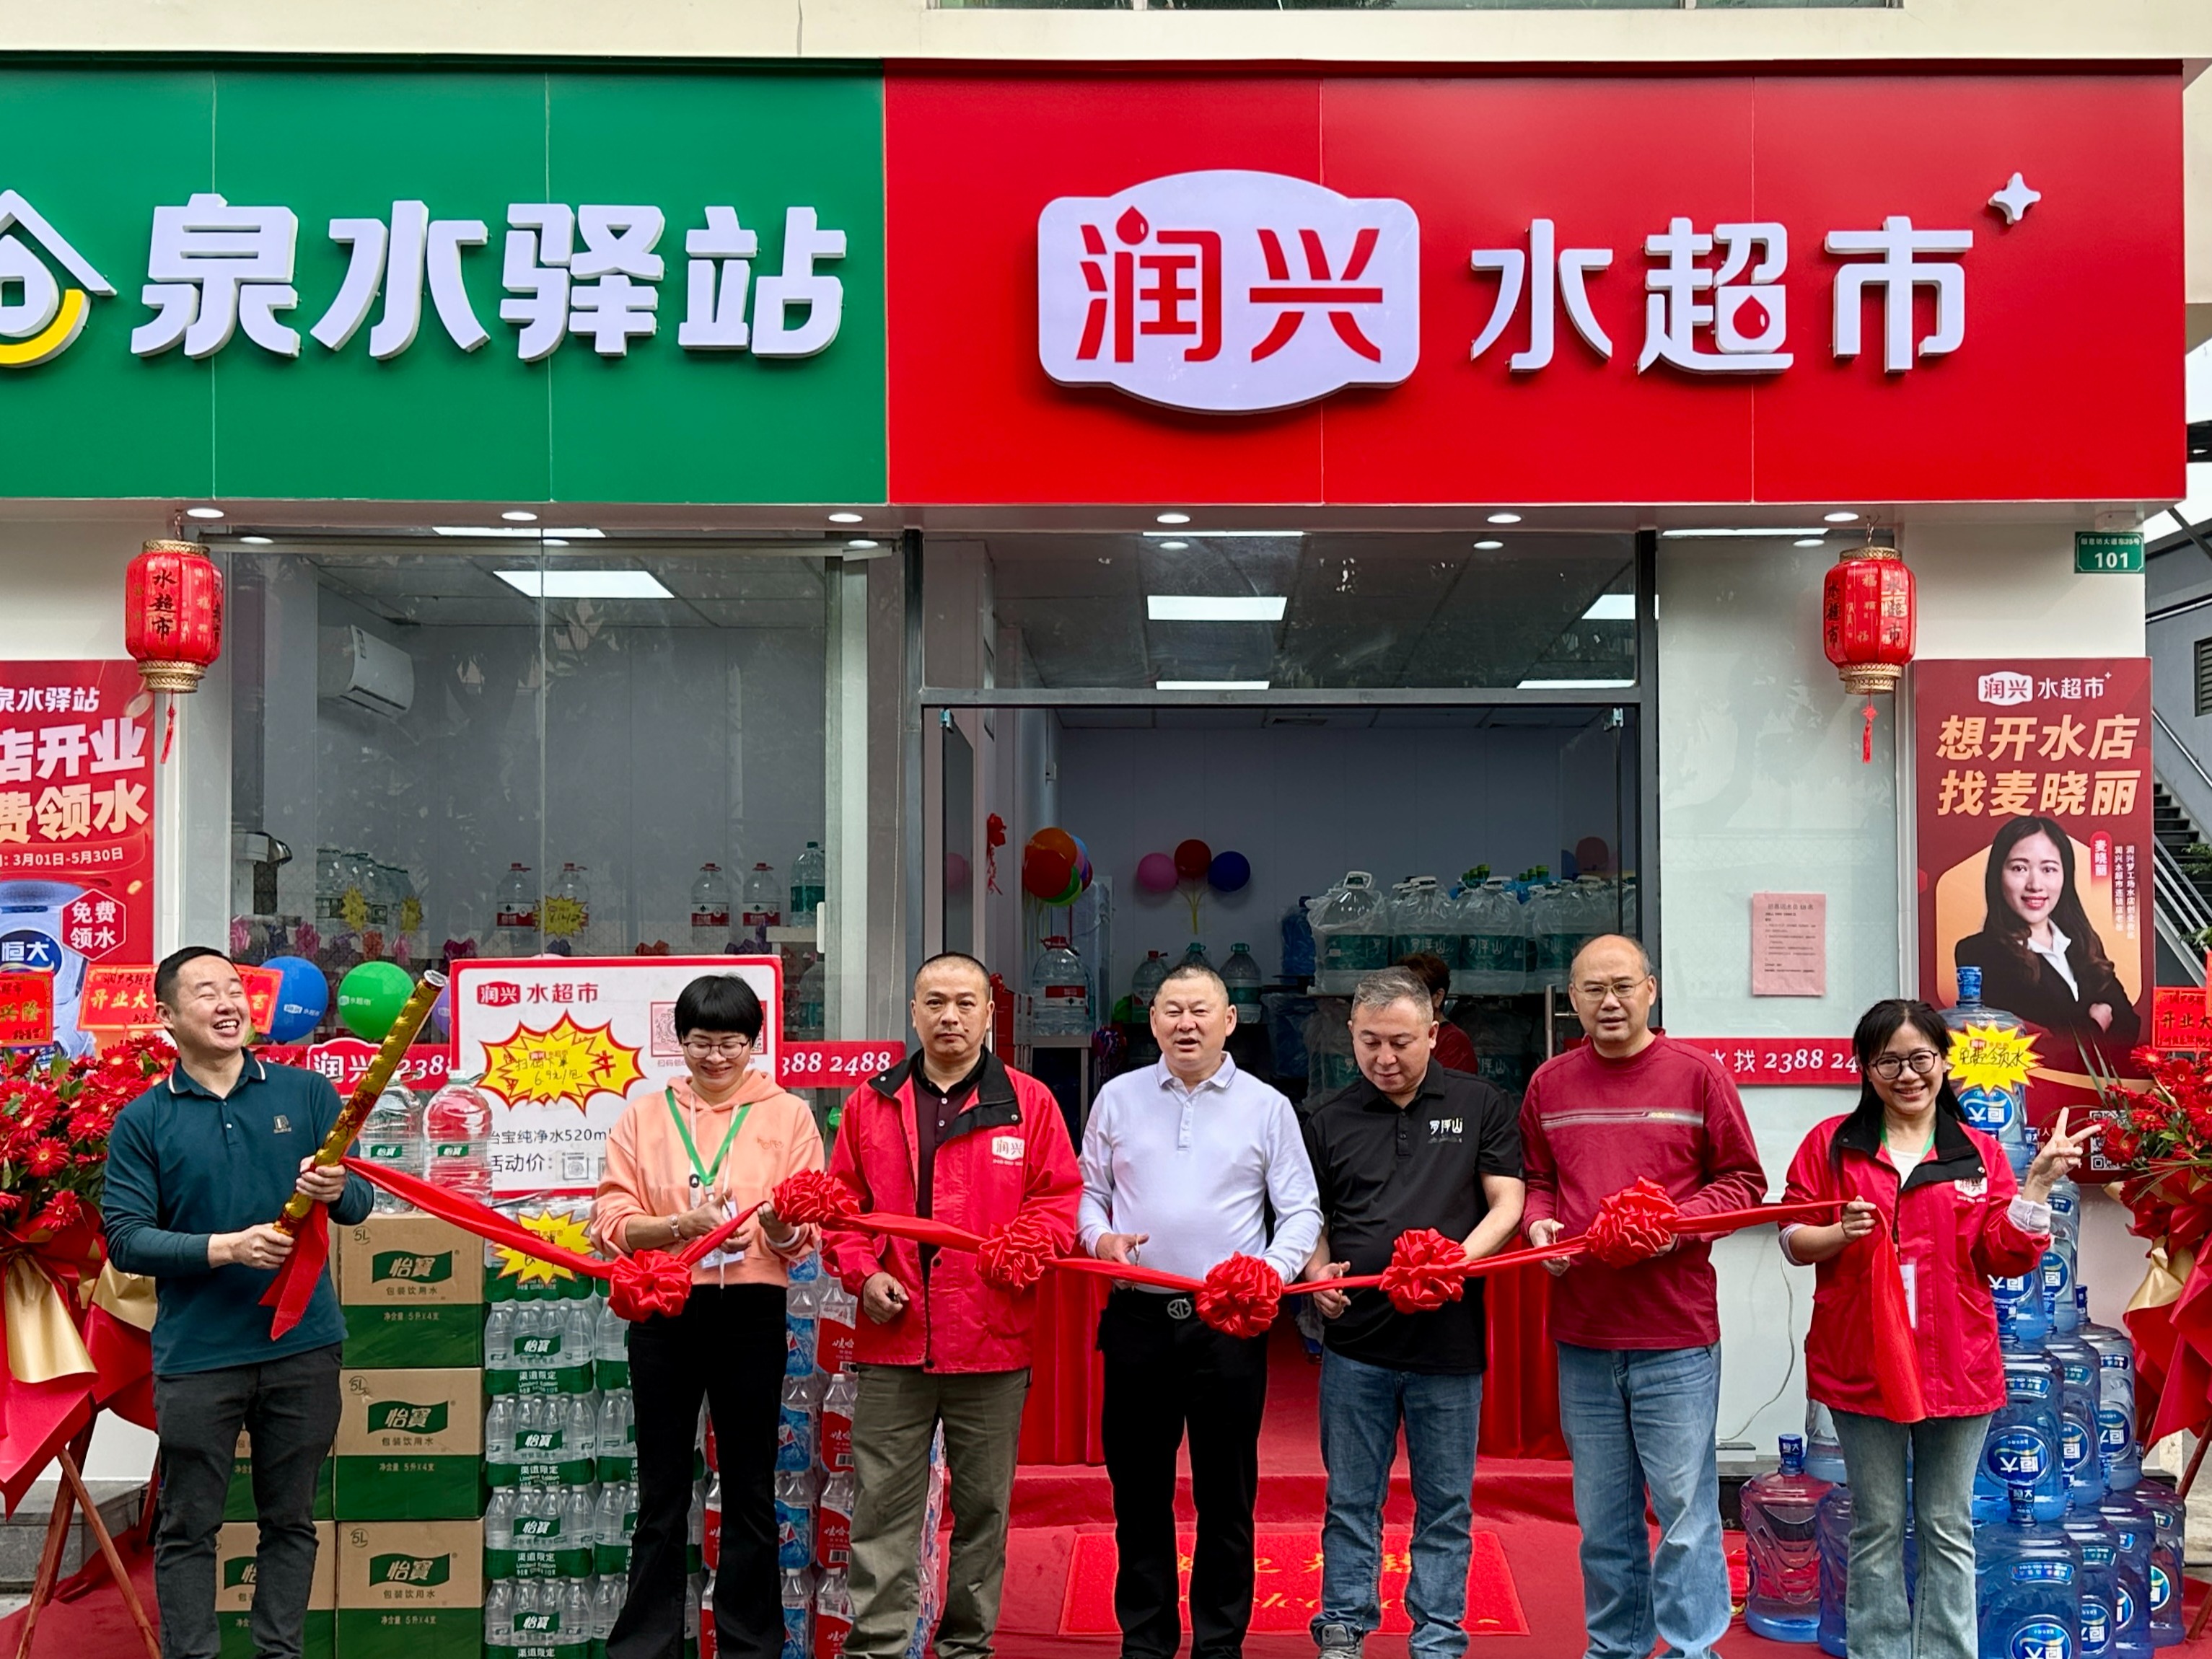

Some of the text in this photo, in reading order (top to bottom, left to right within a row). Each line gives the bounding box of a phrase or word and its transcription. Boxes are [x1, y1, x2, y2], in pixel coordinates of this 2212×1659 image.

[131, 192, 847, 362] 泉水驿站
[1076, 205, 1974, 375] 润兴 水超市
[2094, 552, 2128, 568] 101
[149, 569, 177, 641] 水超市
[1984, 677, 2105, 700] 润兴 水超市
[1936, 714, 2141, 762] 想开水店
[0, 717, 146, 784] 店开业
[1937, 770, 2141, 817] 找麦晓丽
[0, 779, 149, 845] 费领水
[0, 847, 123, 866] ：3月01日-5月30日
[2094, 840, 2107, 876] 麦晓丽
[71, 901, 116, 924] 免费
[70, 926, 116, 949] 领水
[1, 941, 49, 961] 恒大
[480, 983, 598, 1003] 润兴 水超市
[313, 1051, 377, 1083] 润兴
[397, 1055, 449, 1081] 238
[829, 1051, 892, 1076] 2488
[1764, 1049, 1824, 1073] 2388
[996, 1140, 1023, 1156] 润兴
[354, 1228, 371, 1242] 5L
[386, 1286, 438, 1296] 包装饮用水
[382, 1436, 434, 1447] 包装饮用水
[379, 1463, 399, 1471] 净含量
[383, 1590, 435, 1599] 包装饮用水
[381, 1616, 400, 1625] 净含量
